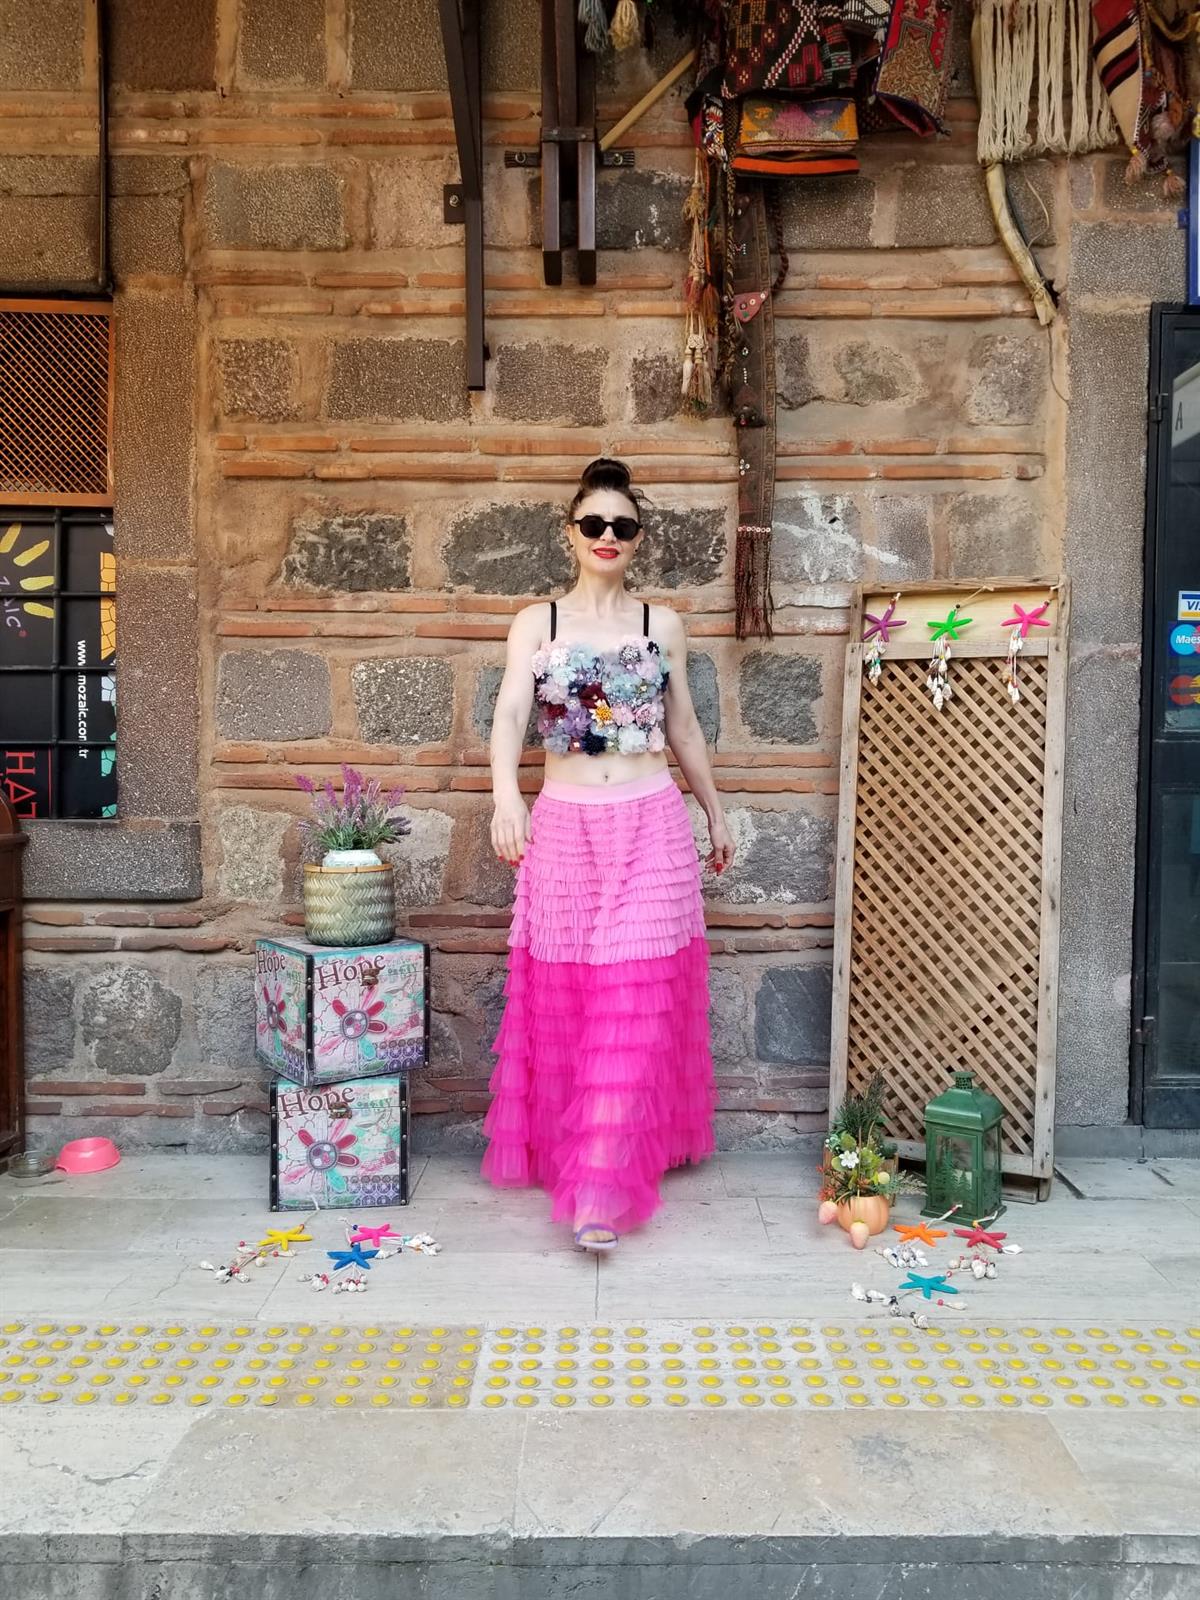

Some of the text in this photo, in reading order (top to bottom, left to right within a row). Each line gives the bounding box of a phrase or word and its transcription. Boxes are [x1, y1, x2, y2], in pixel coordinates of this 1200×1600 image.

[1187, 601, 1200, 611] VI
[256, 950, 286, 981] Hope
[315, 954, 387, 991] Hope
[278, 1087, 355, 1120] Hope
